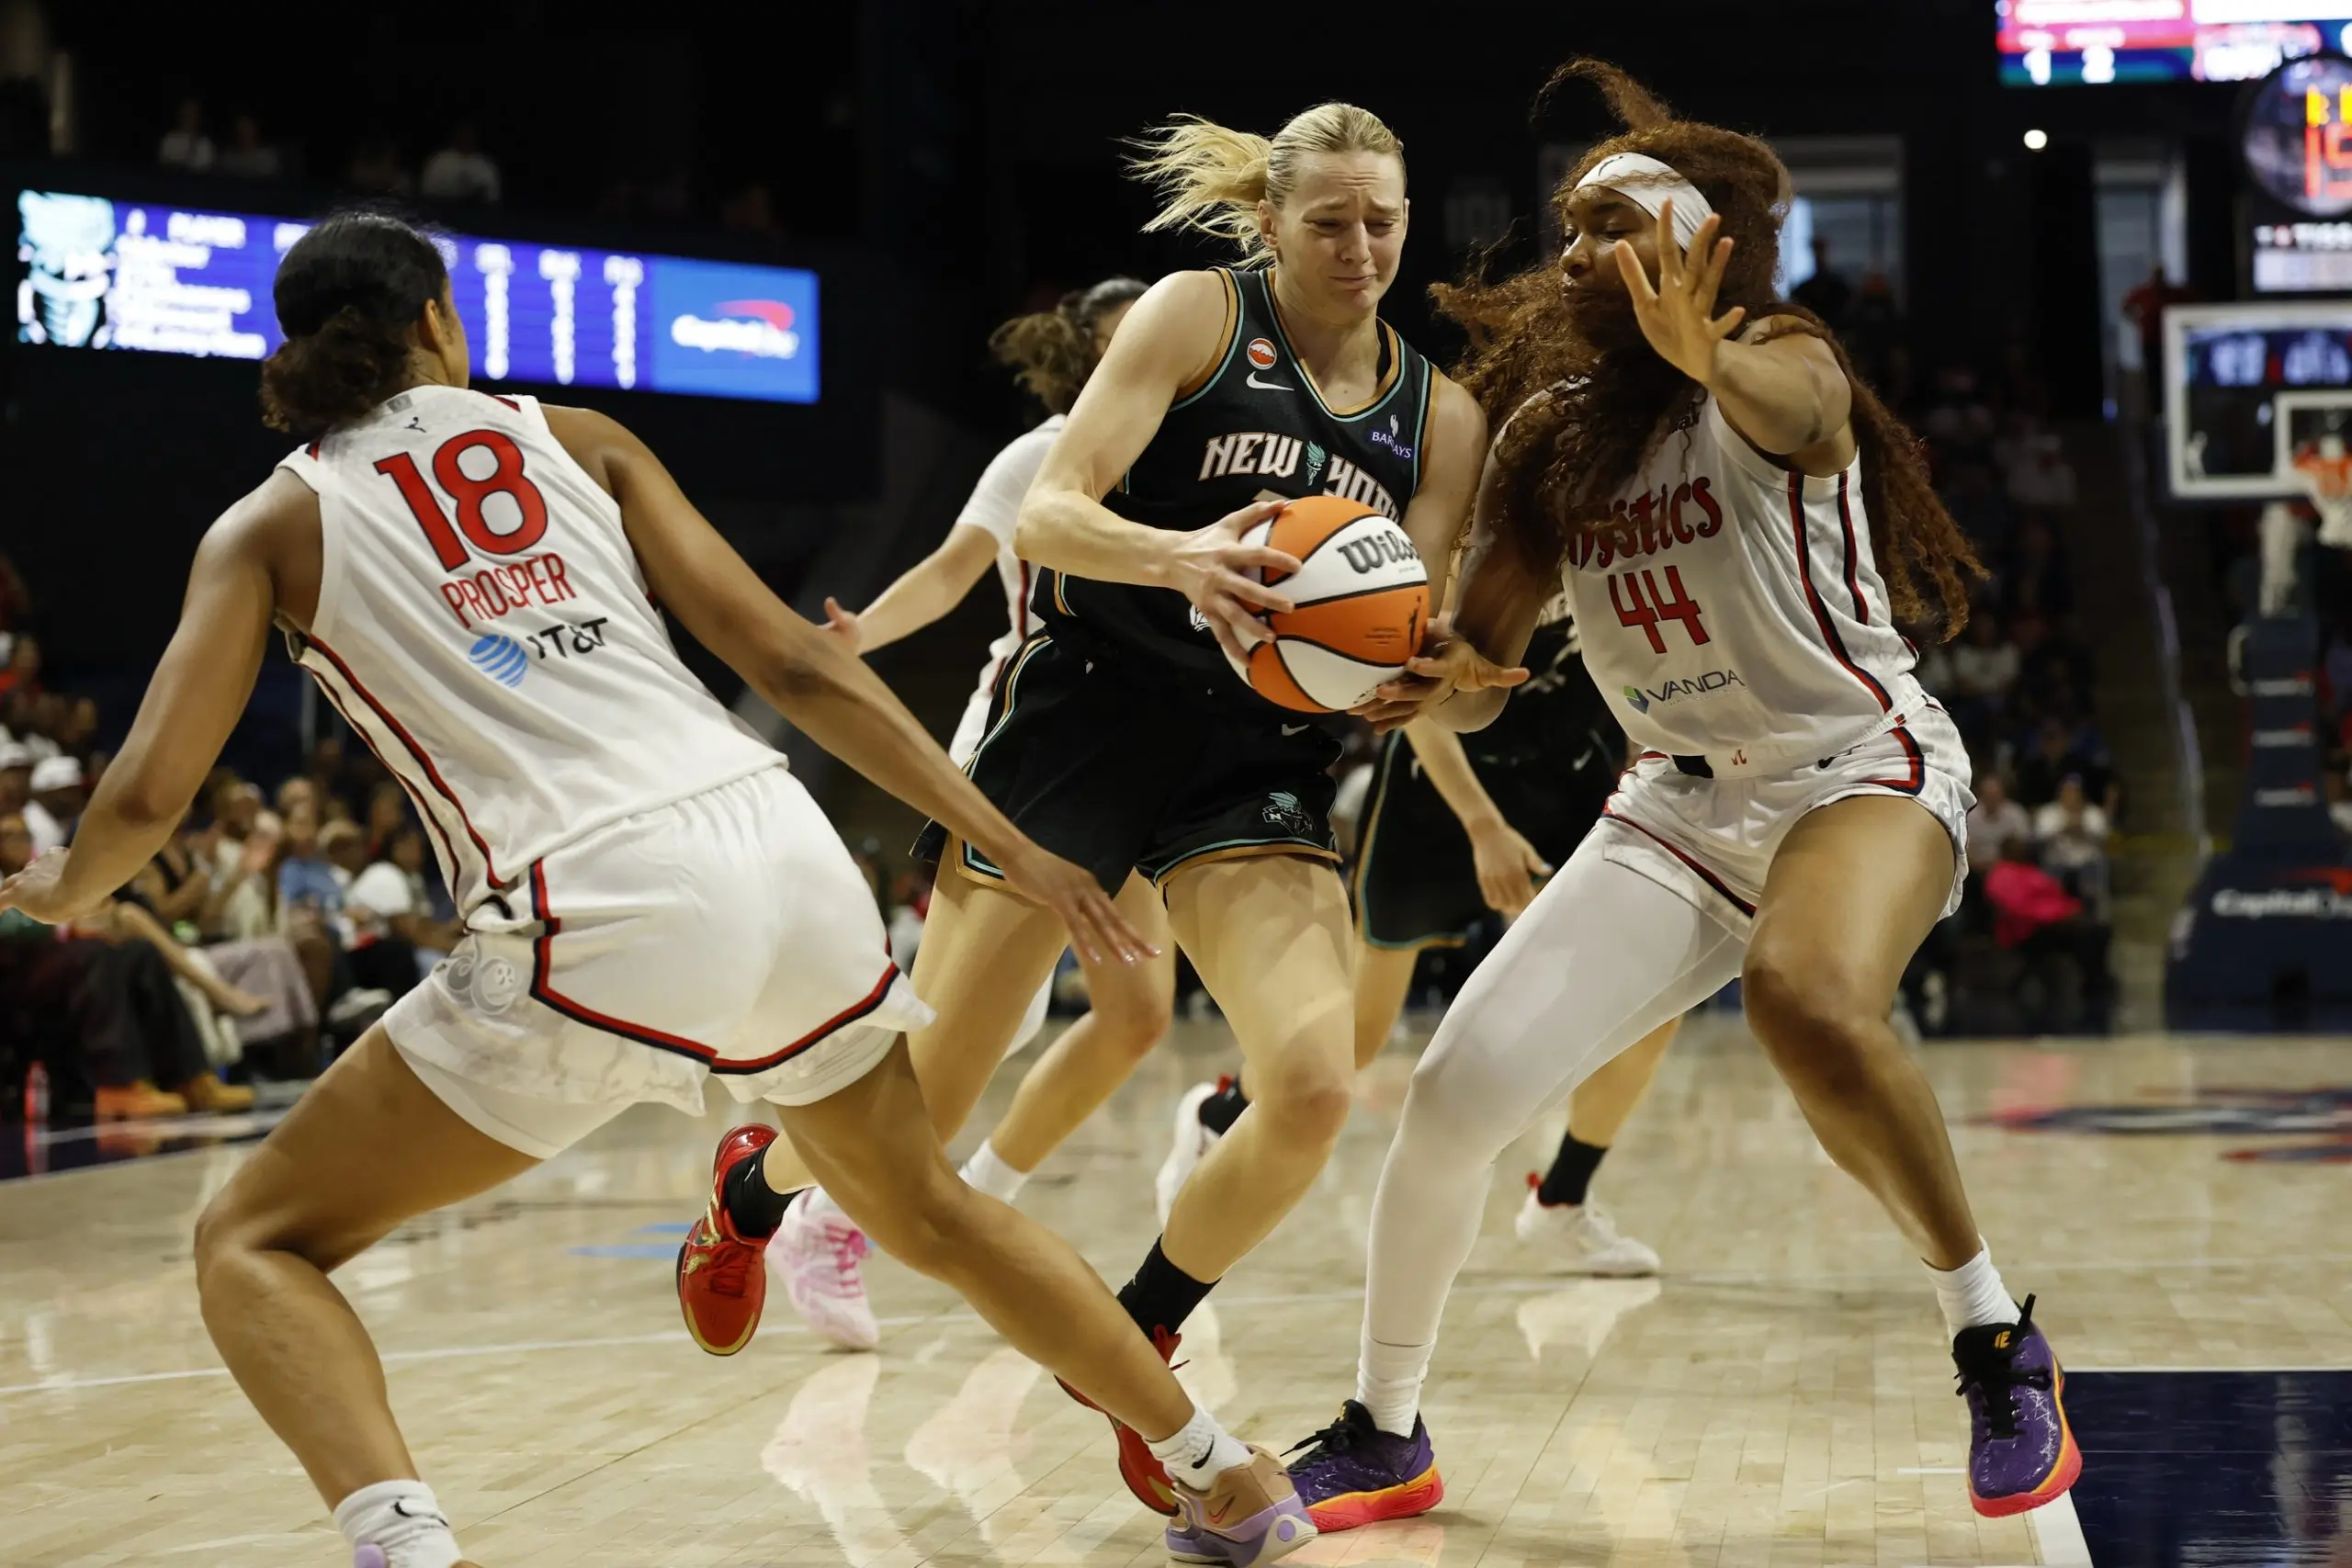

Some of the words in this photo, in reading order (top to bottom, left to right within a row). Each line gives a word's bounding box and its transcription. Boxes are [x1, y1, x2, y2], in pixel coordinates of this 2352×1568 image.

[1198, 432, 1304, 481] NEW
[373, 428, 548, 573] 18
[440, 553, 577, 629] PROSPER
[1608, 565, 1712, 655] 44
[1645, 669, 1746, 702] VANDA
